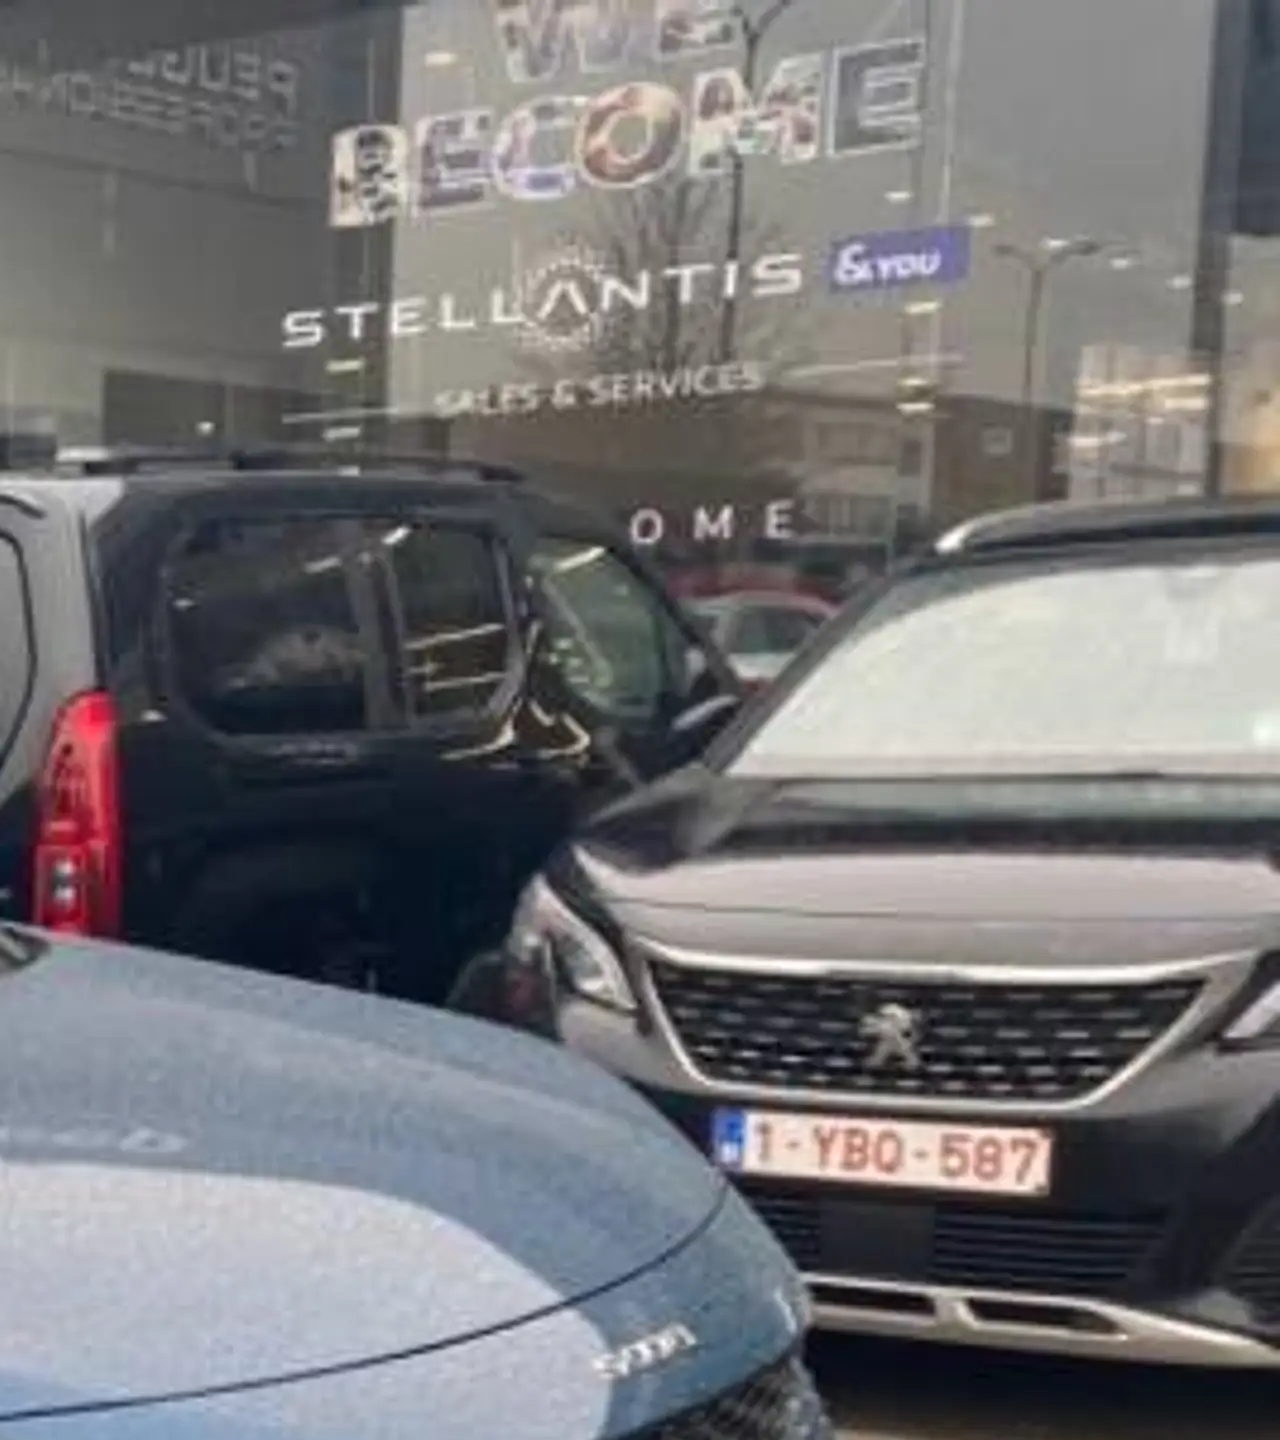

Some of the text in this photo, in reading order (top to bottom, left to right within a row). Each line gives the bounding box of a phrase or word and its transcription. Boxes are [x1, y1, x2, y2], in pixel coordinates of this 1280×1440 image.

[330, 36, 924, 226] BECOME
[282, 252, 804, 348] STELLANTIS
[583, 363, 768, 406] SERVICES
